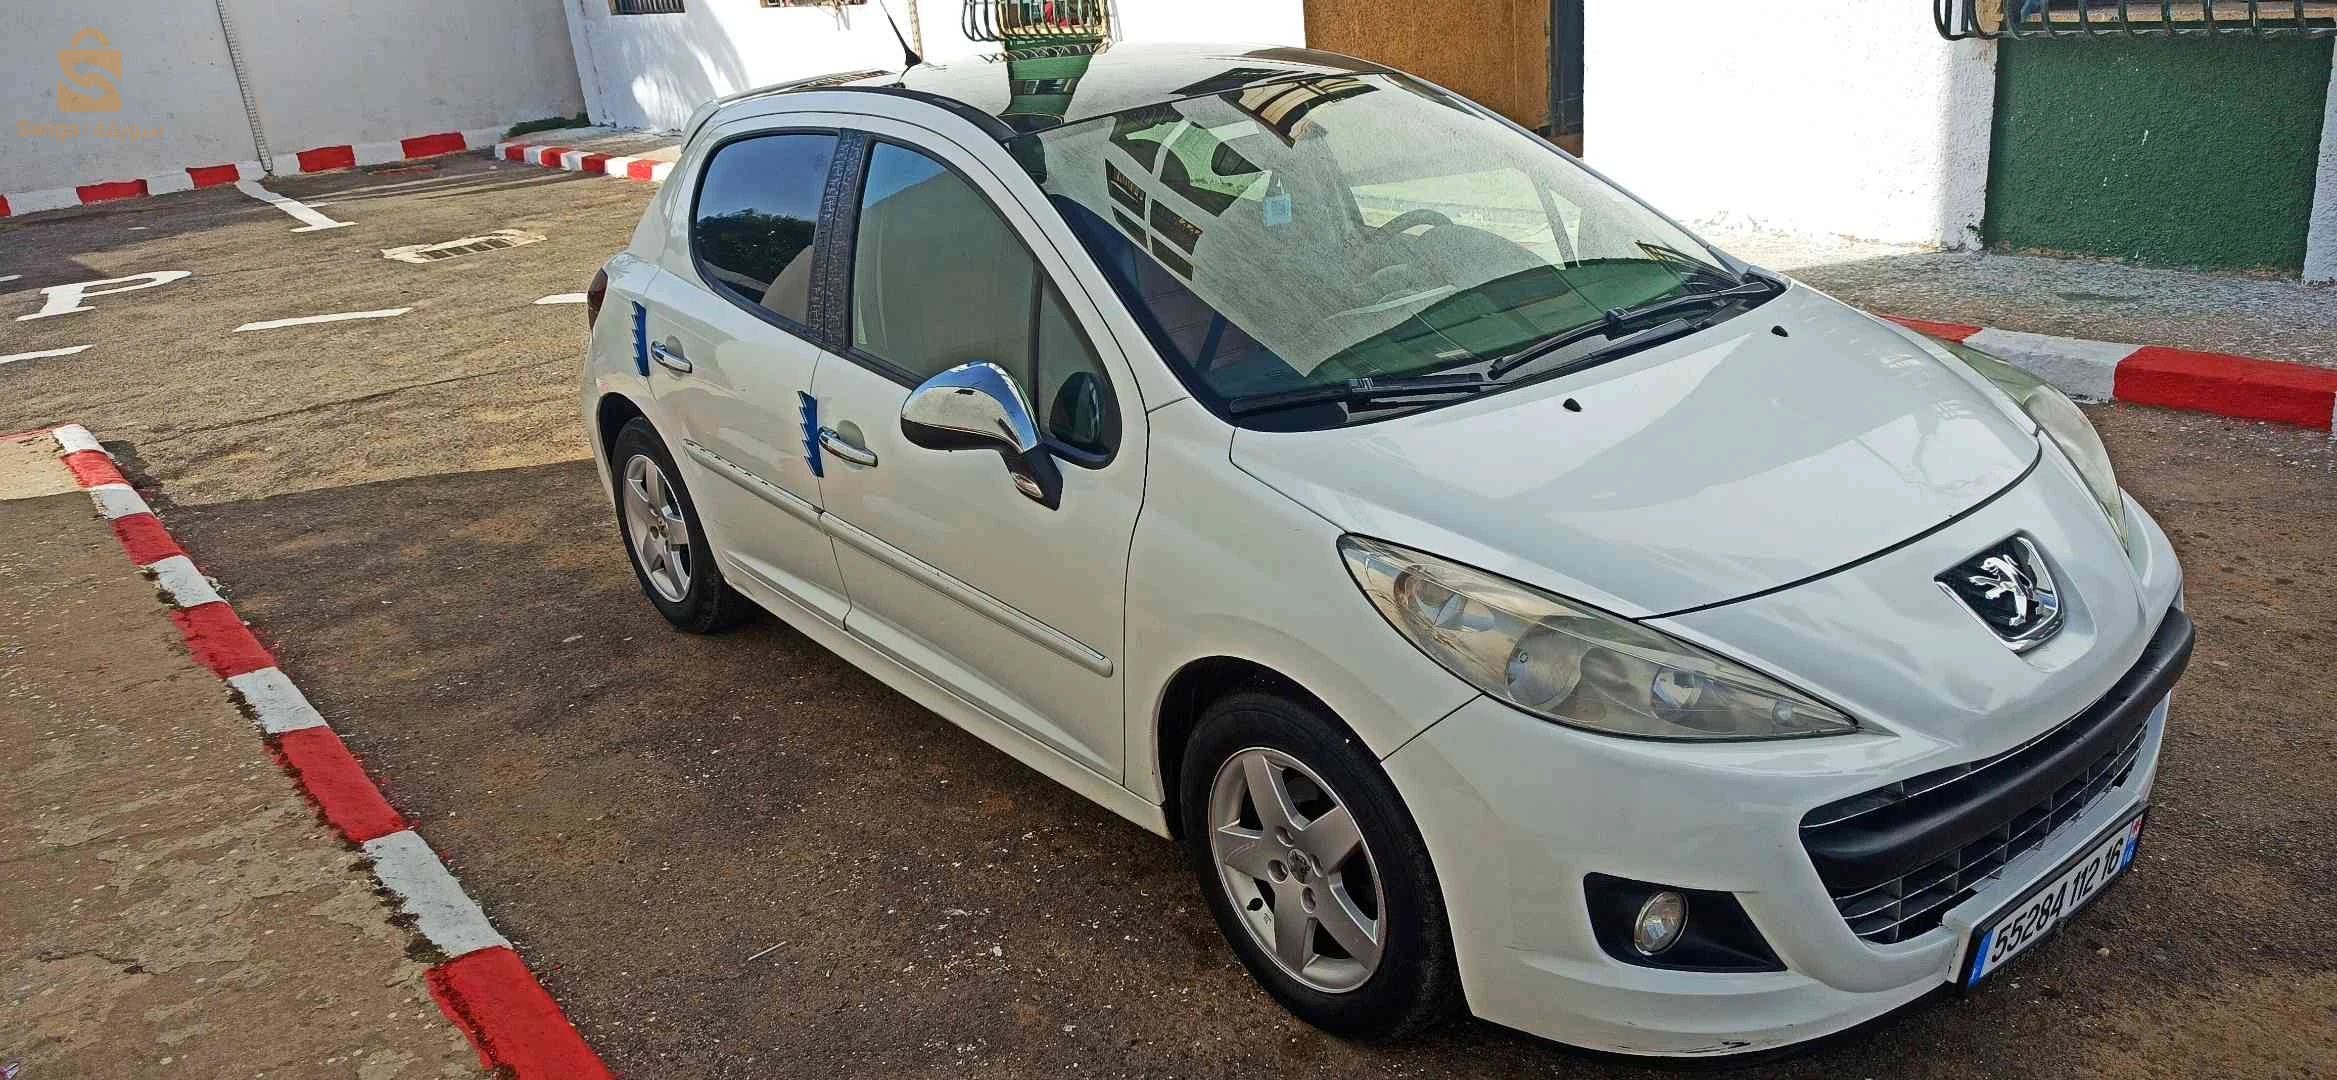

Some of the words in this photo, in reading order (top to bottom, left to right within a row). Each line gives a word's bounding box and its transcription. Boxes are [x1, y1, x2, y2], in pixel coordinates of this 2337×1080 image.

[15, 270, 193, 322] P
[1991, 882, 2067, 963] 55284
[2069, 856, 2101, 907] 112
[2100, 837, 2124, 881] 16
